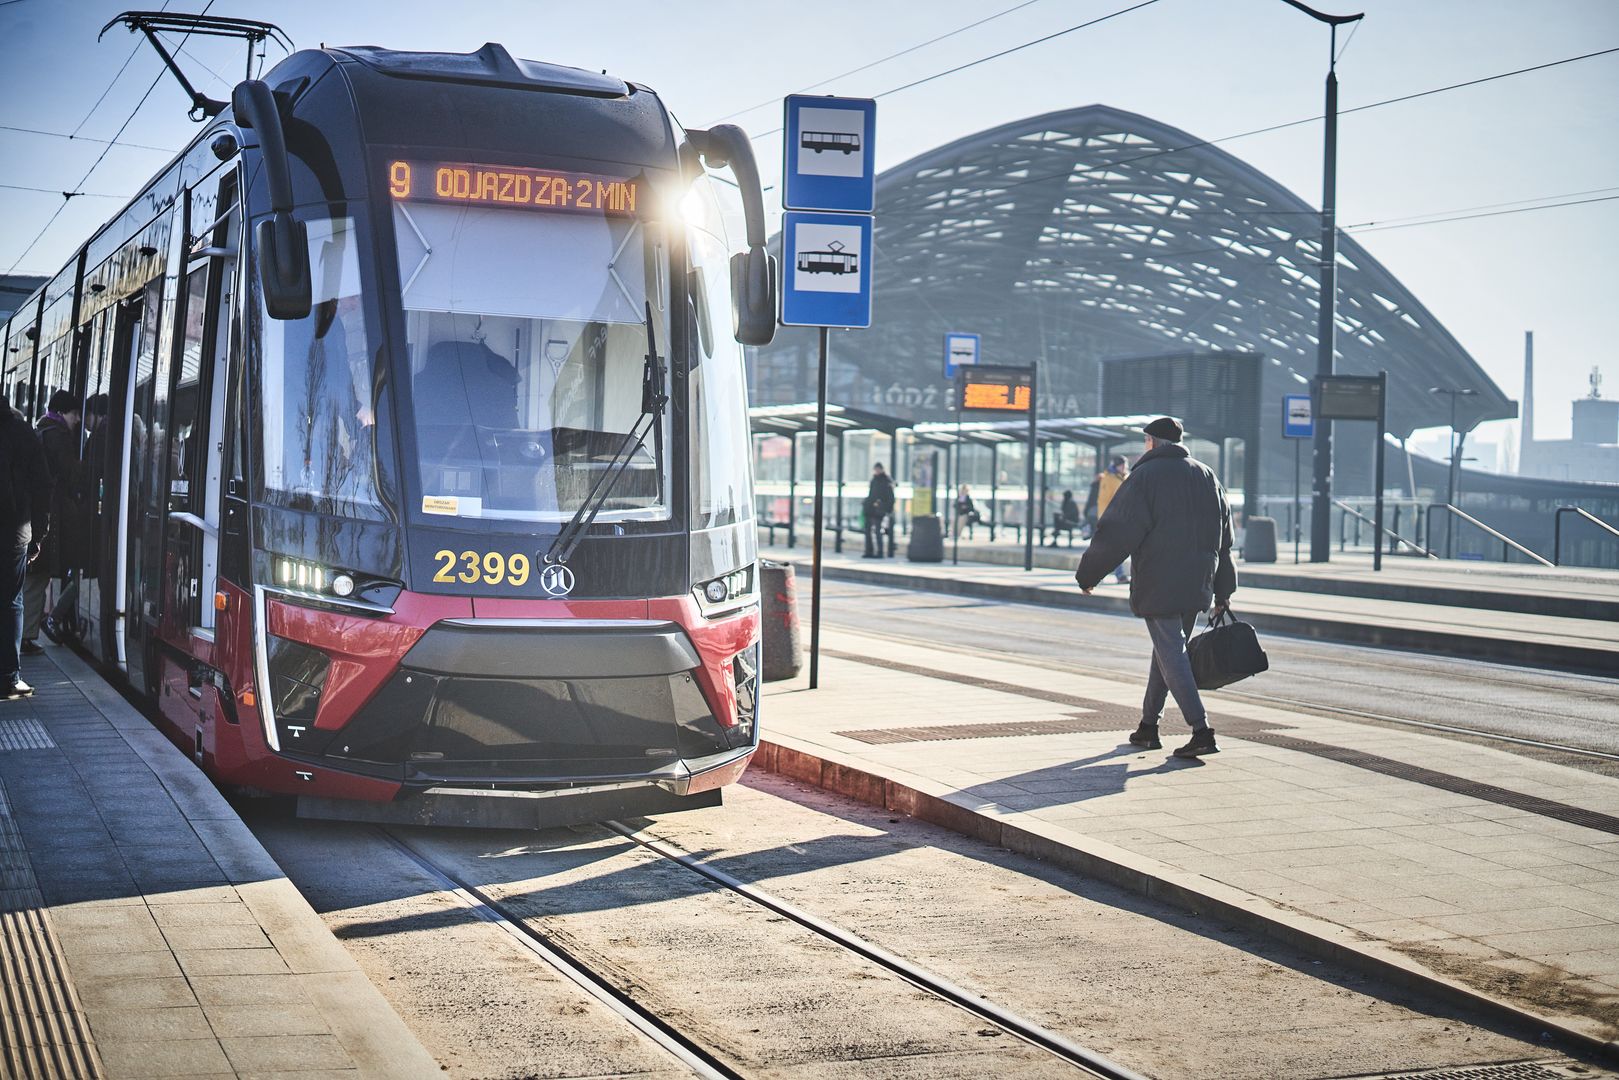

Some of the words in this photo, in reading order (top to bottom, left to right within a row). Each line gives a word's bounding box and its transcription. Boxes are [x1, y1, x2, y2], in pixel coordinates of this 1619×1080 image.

[390, 161, 411, 198] 9
[436, 168, 531, 203] ODJAZD
[535, 176, 572, 206] ZA:
[576, 180, 592, 208] 2
[596, 181, 637, 211] MIN
[432, 549, 530, 586] 2399
